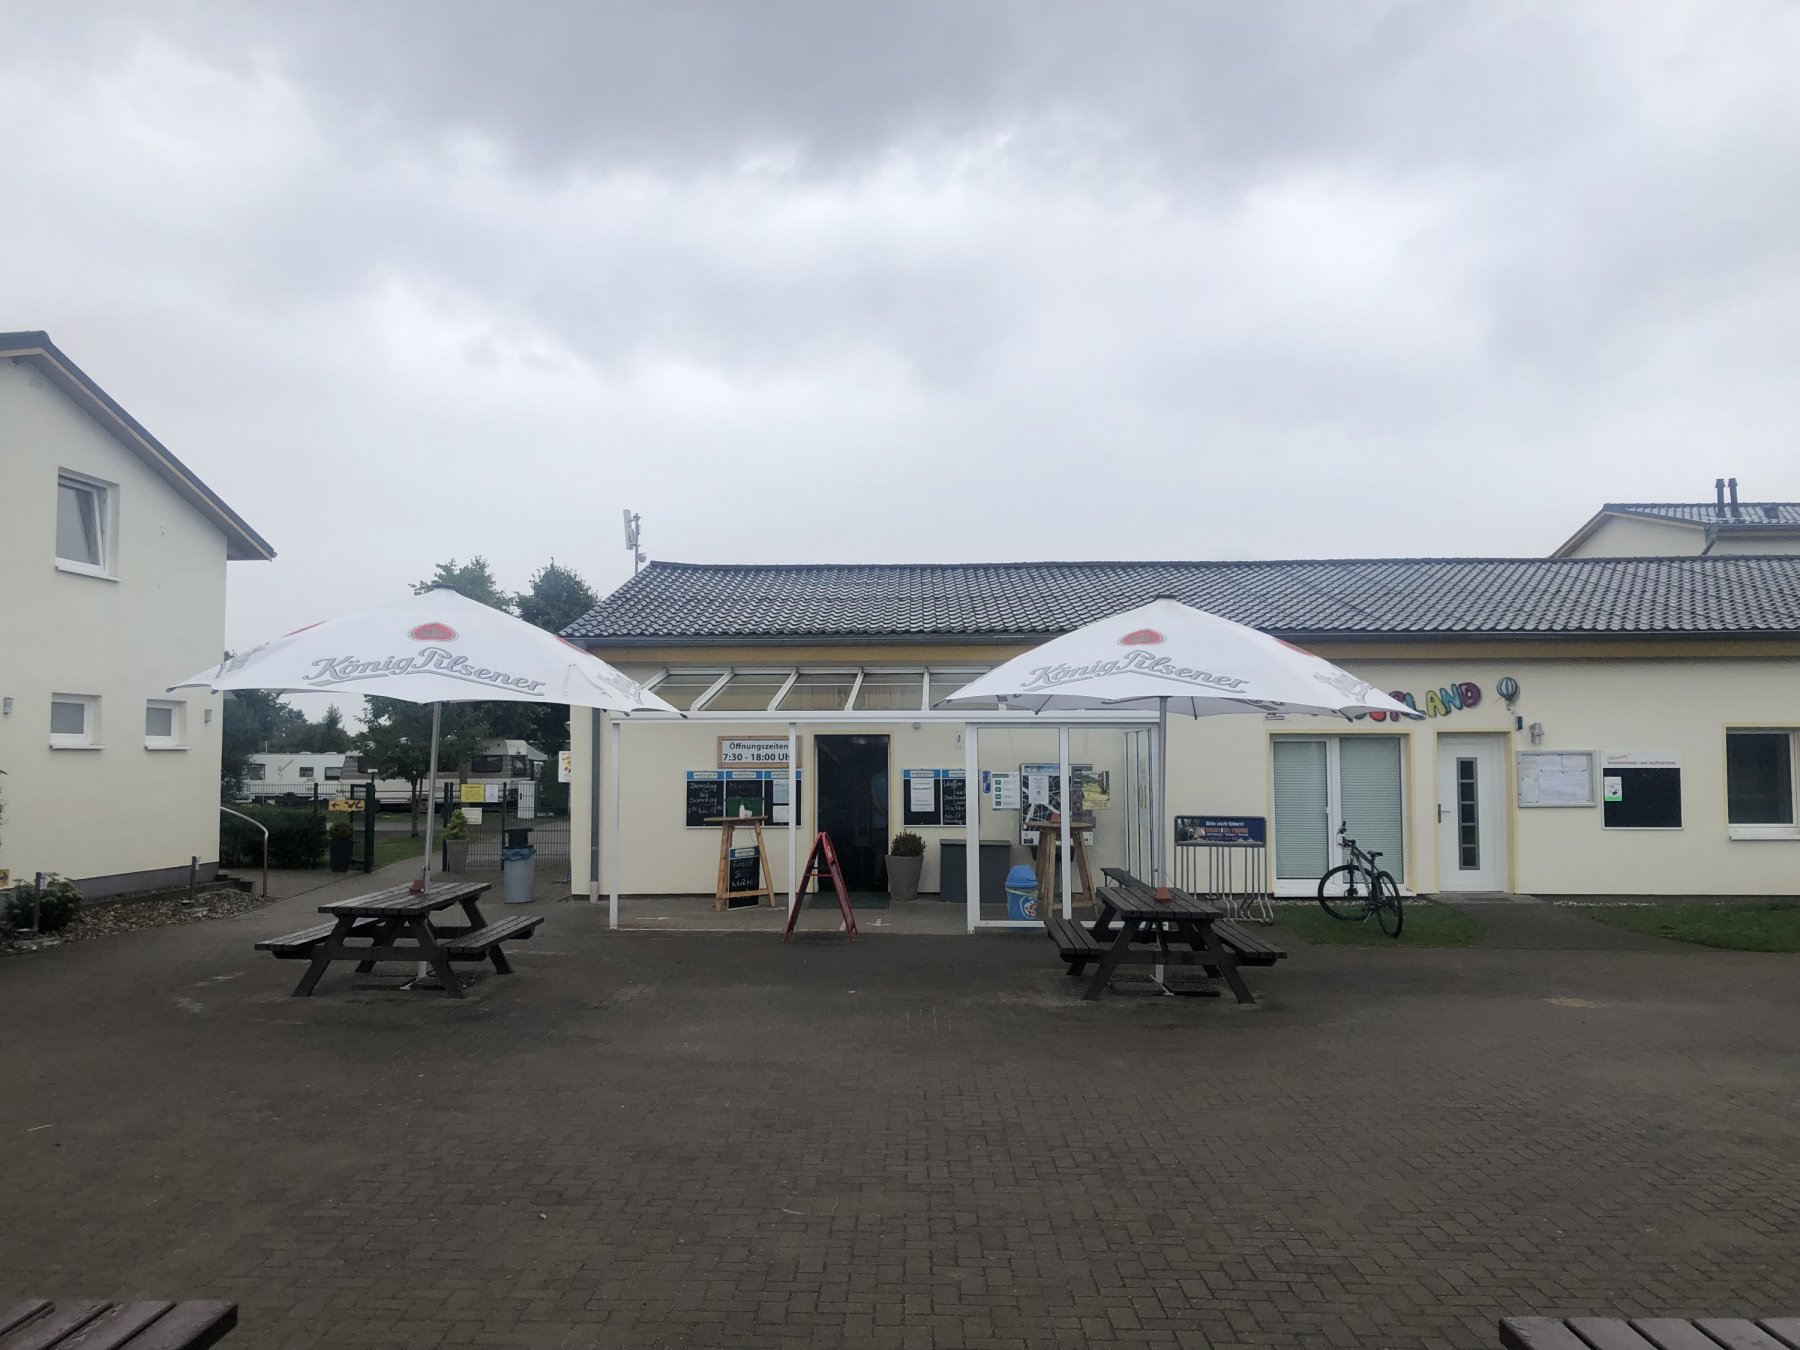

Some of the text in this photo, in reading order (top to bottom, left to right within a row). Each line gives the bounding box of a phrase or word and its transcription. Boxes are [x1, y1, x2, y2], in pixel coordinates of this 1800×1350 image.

[302, 647, 546, 692] König Pilsener
[1019, 649, 1250, 691] König Pilsener
[729, 742, 789, 751] Öffnungszeiten
[723, 753, 742, 761] 7:30
[751, 753, 776, 761] 18:00
[778, 753, 790, 761] Uh
[345, 800, 364, 809] WC
